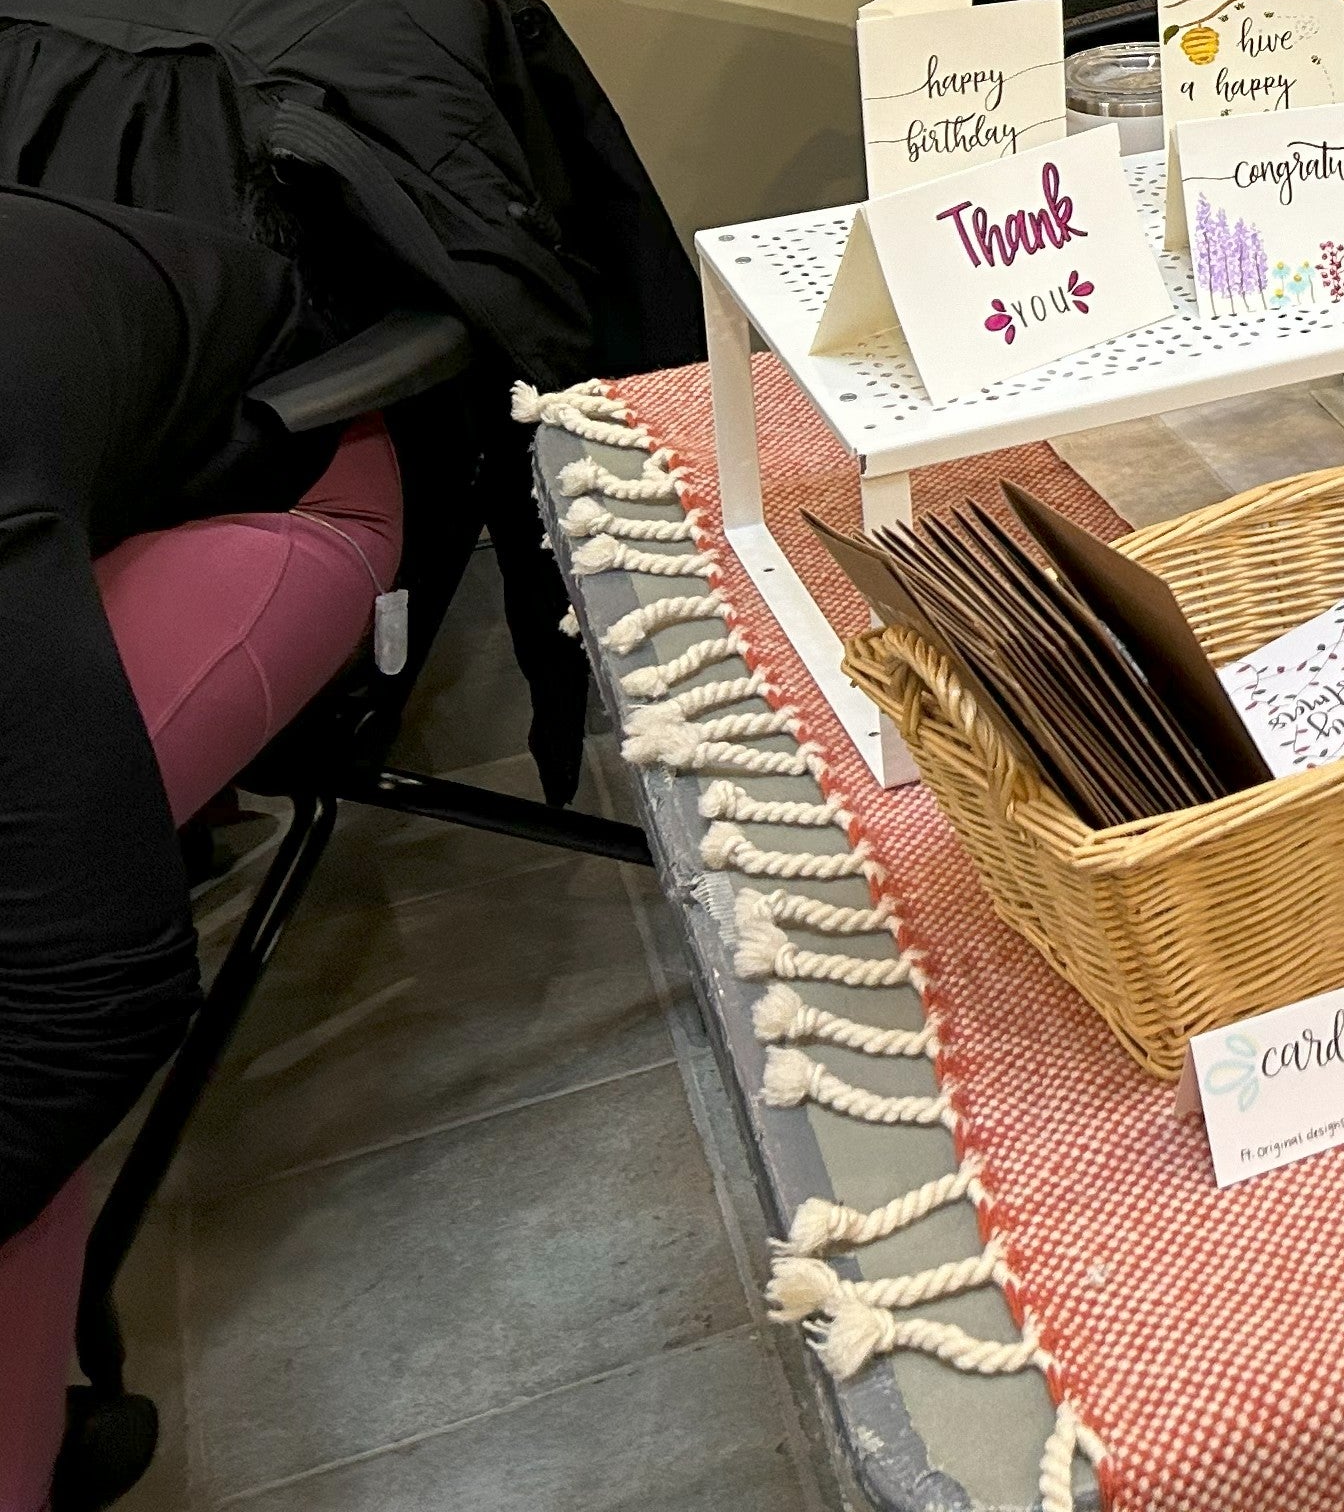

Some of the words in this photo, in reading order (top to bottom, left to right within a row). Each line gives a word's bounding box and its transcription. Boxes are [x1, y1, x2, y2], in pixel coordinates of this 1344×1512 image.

[1236, 16, 1295, 58] hive
[908, 54, 1018, 112] happy
[1180, 81, 1195, 102] a
[1215, 66, 1298, 111] happy
[898, 113, 1026, 163] birthday
[935, 161, 1088, 269] Thank
[1010, 286, 1071, 329] YOU
